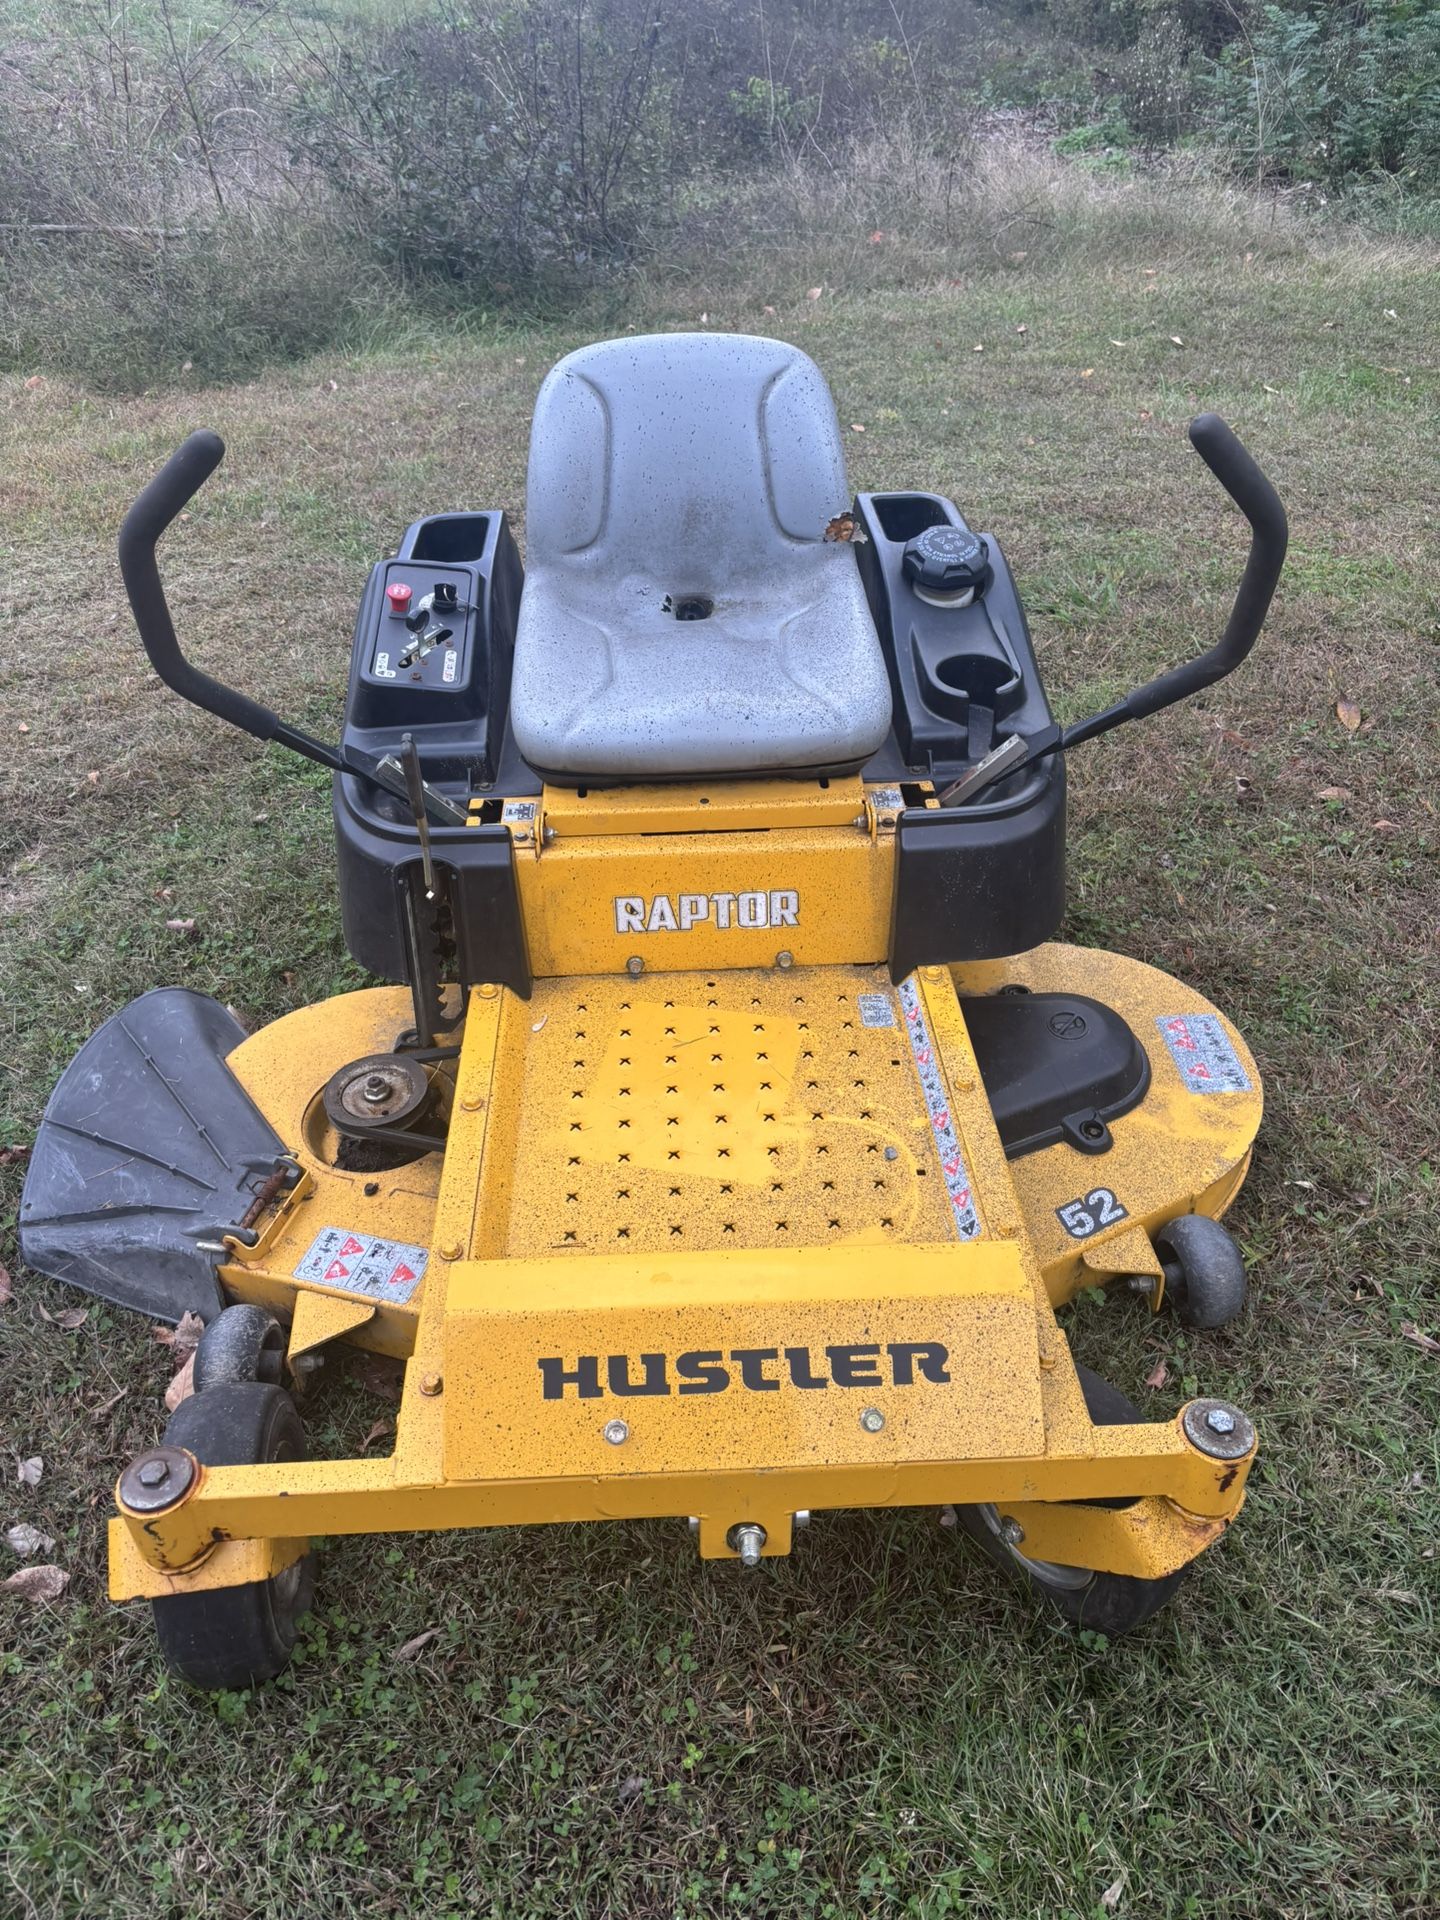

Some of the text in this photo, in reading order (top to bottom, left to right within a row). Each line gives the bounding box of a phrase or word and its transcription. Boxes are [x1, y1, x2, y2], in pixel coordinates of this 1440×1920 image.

[614, 889, 800, 933] RAPTOR
[1058, 1188, 1125, 1237] 52
[538, 1341, 951, 1400] HUSTLER
